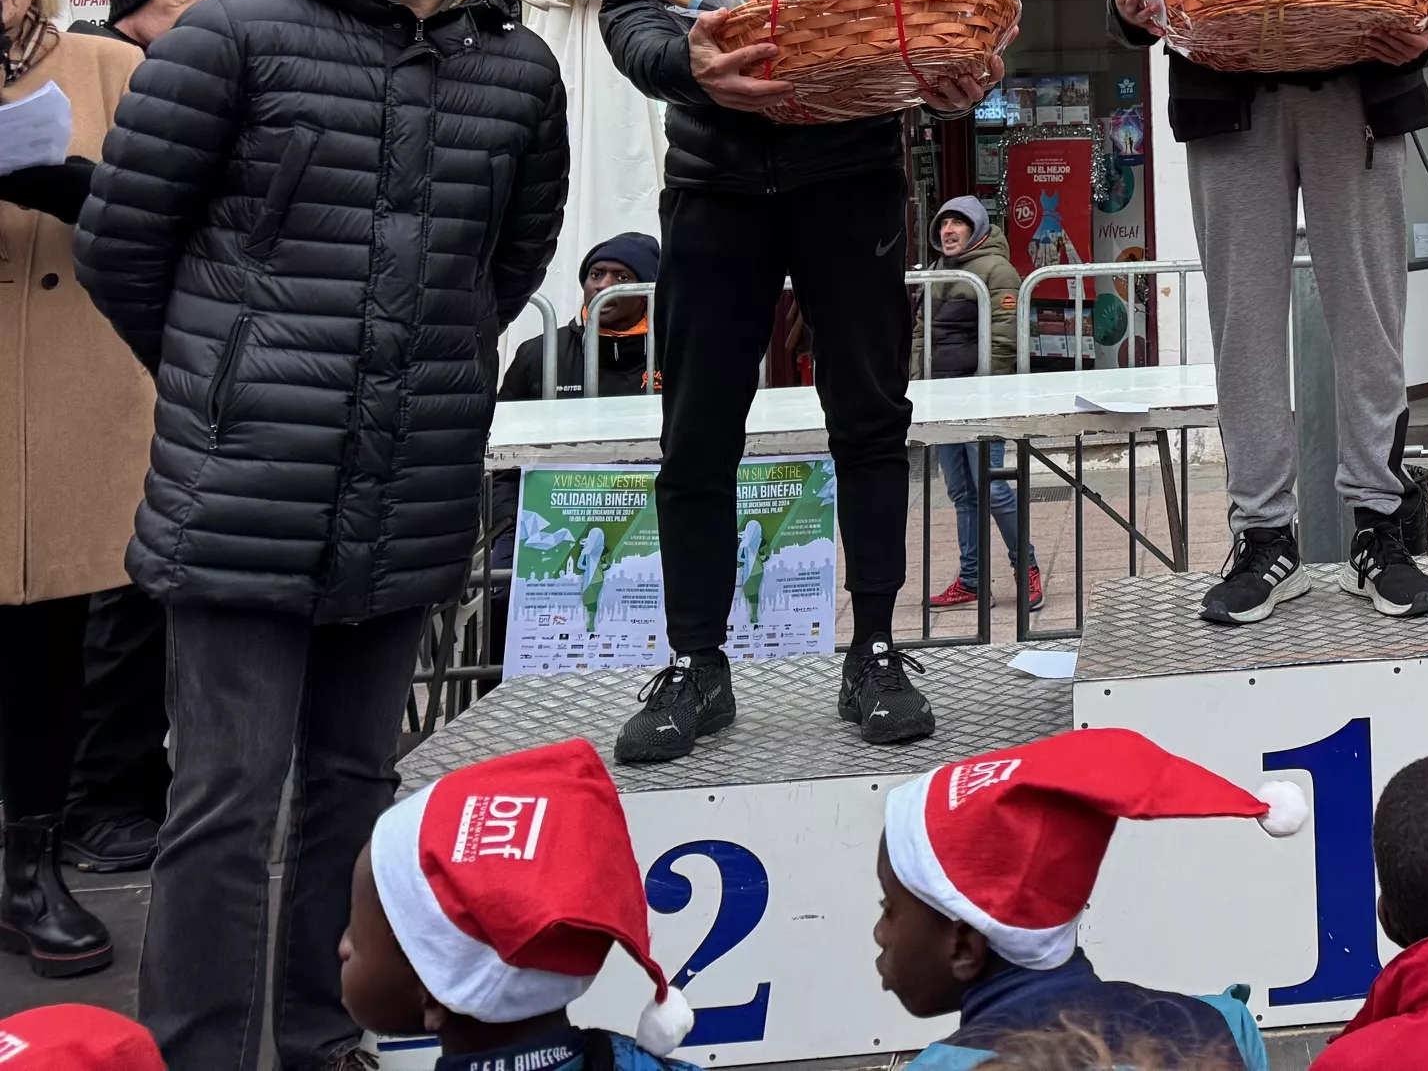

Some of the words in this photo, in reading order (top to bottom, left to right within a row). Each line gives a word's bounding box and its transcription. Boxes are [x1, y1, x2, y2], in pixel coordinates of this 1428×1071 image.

[1027, 166, 1038, 174] EN
[1039, 166, 1046, 174] EL
[1047, 166, 1071, 174] MEJOR
[1033, 174, 1064, 183] DESTINO
[574, 474, 595, 488] SAN
[597, 474, 647, 488] SILVESTRE
[751, 465, 801, 481] SILVESTRE
[551, 492, 601, 506] SOLIDARIA
[605, 490, 647, 506] BINÉFAR
[760, 481, 803, 499] BINÉFAR
[479, 795, 535, 860] bnf
[1262, 716, 1383, 1007] 1
[644, 839, 771, 1047] 2
